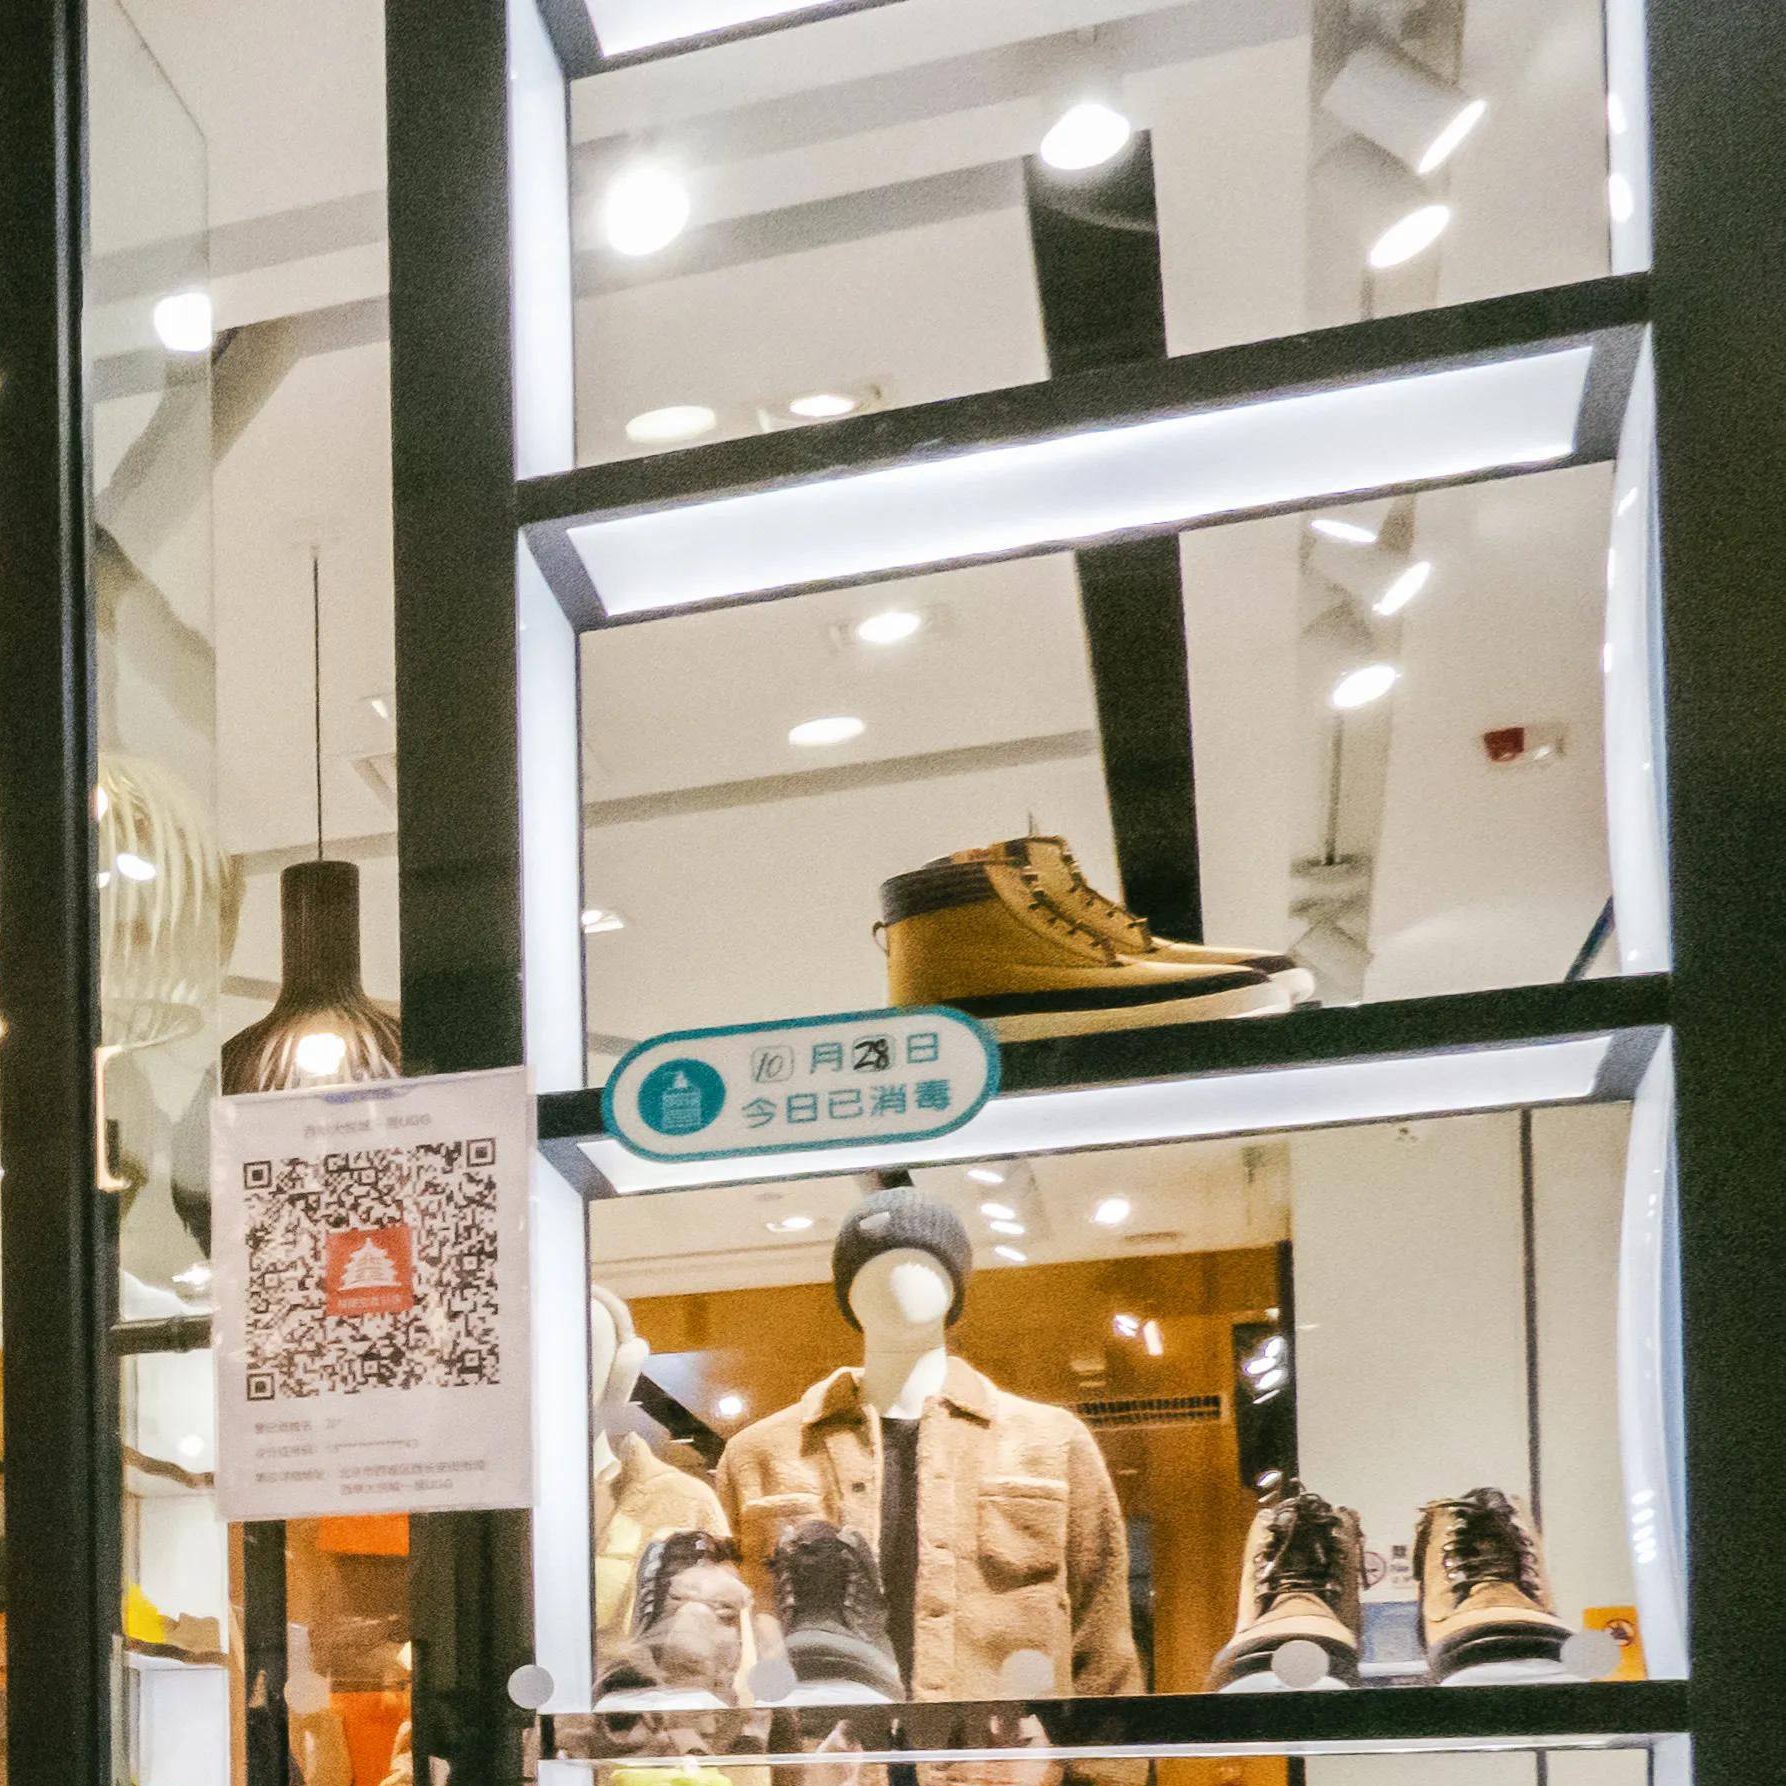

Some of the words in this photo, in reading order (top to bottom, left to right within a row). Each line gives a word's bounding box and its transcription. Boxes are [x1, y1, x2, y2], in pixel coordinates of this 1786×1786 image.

[741, 1079, 951, 1129] 今日已消毒
